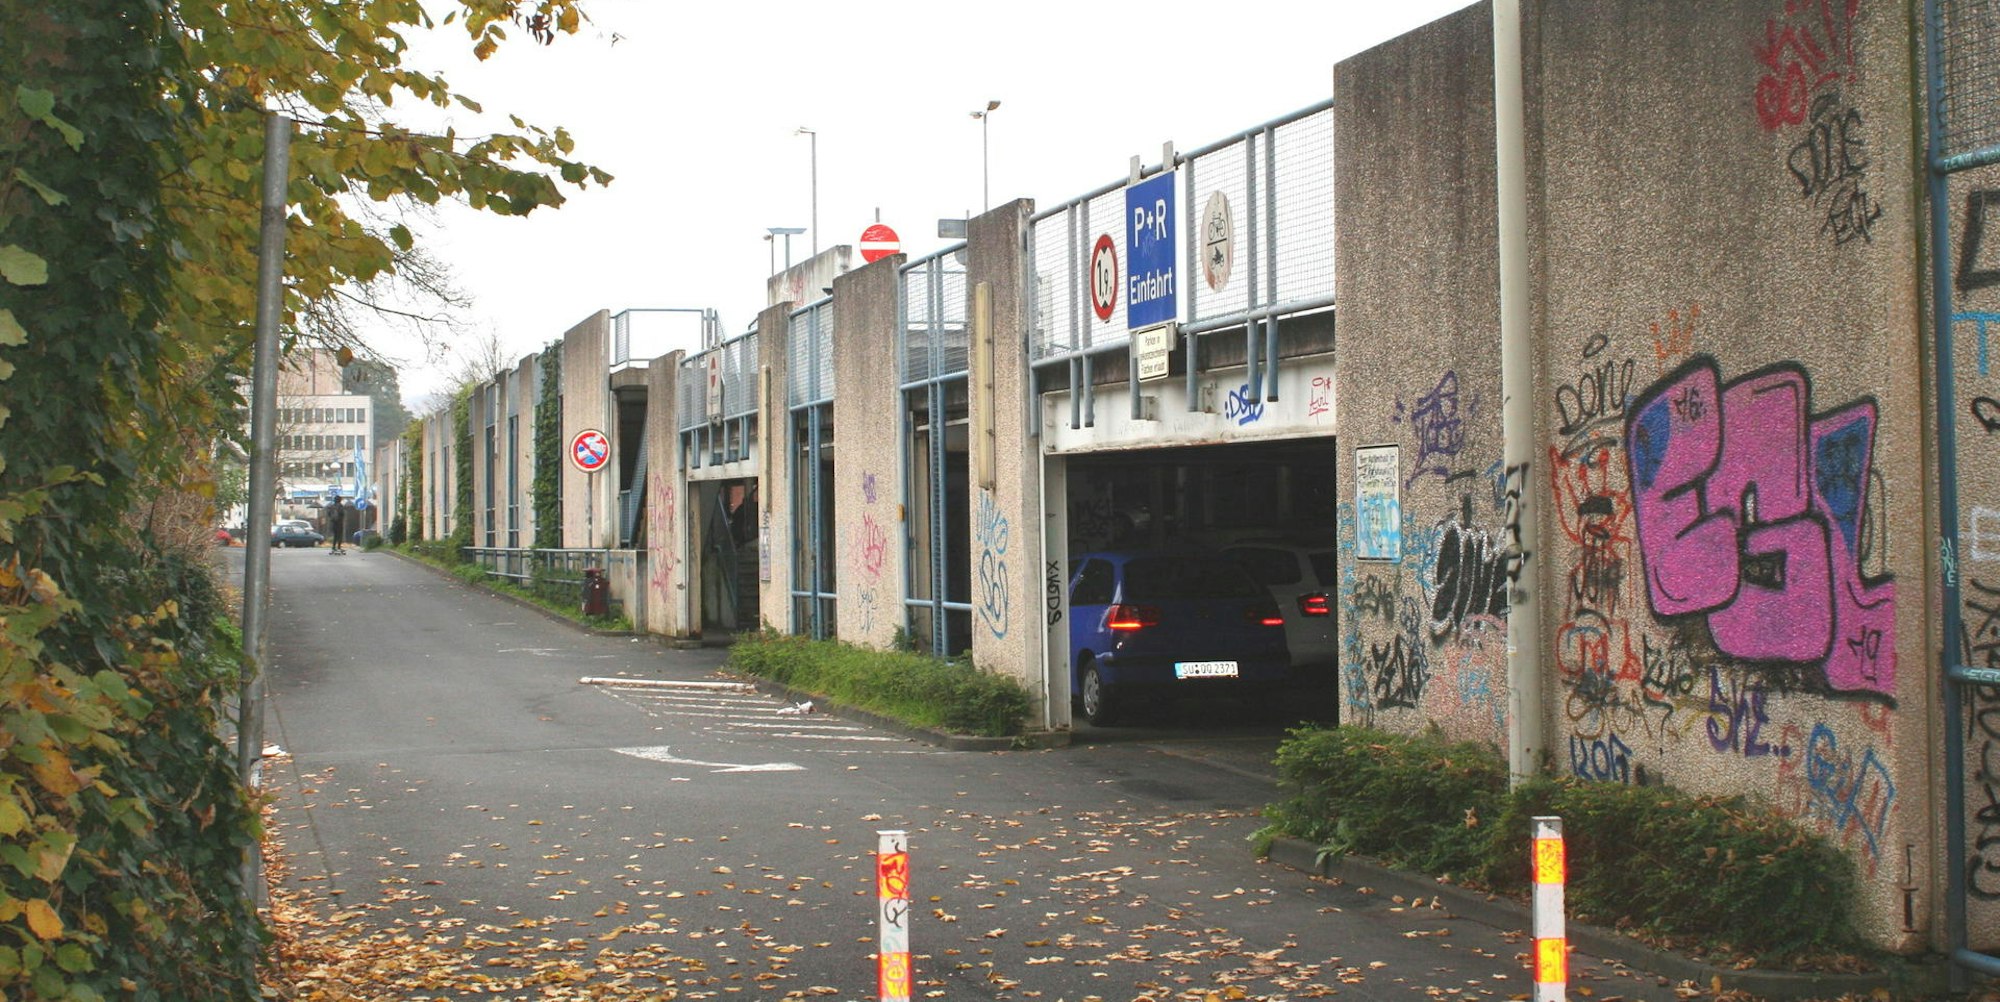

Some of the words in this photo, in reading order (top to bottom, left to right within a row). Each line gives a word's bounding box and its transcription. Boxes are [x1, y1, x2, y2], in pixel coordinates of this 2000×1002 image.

[1134, 198, 1167, 248] P+R
[1130, 266, 1173, 305] Einfahrt
[1214, 662, 1236, 674] 2371
